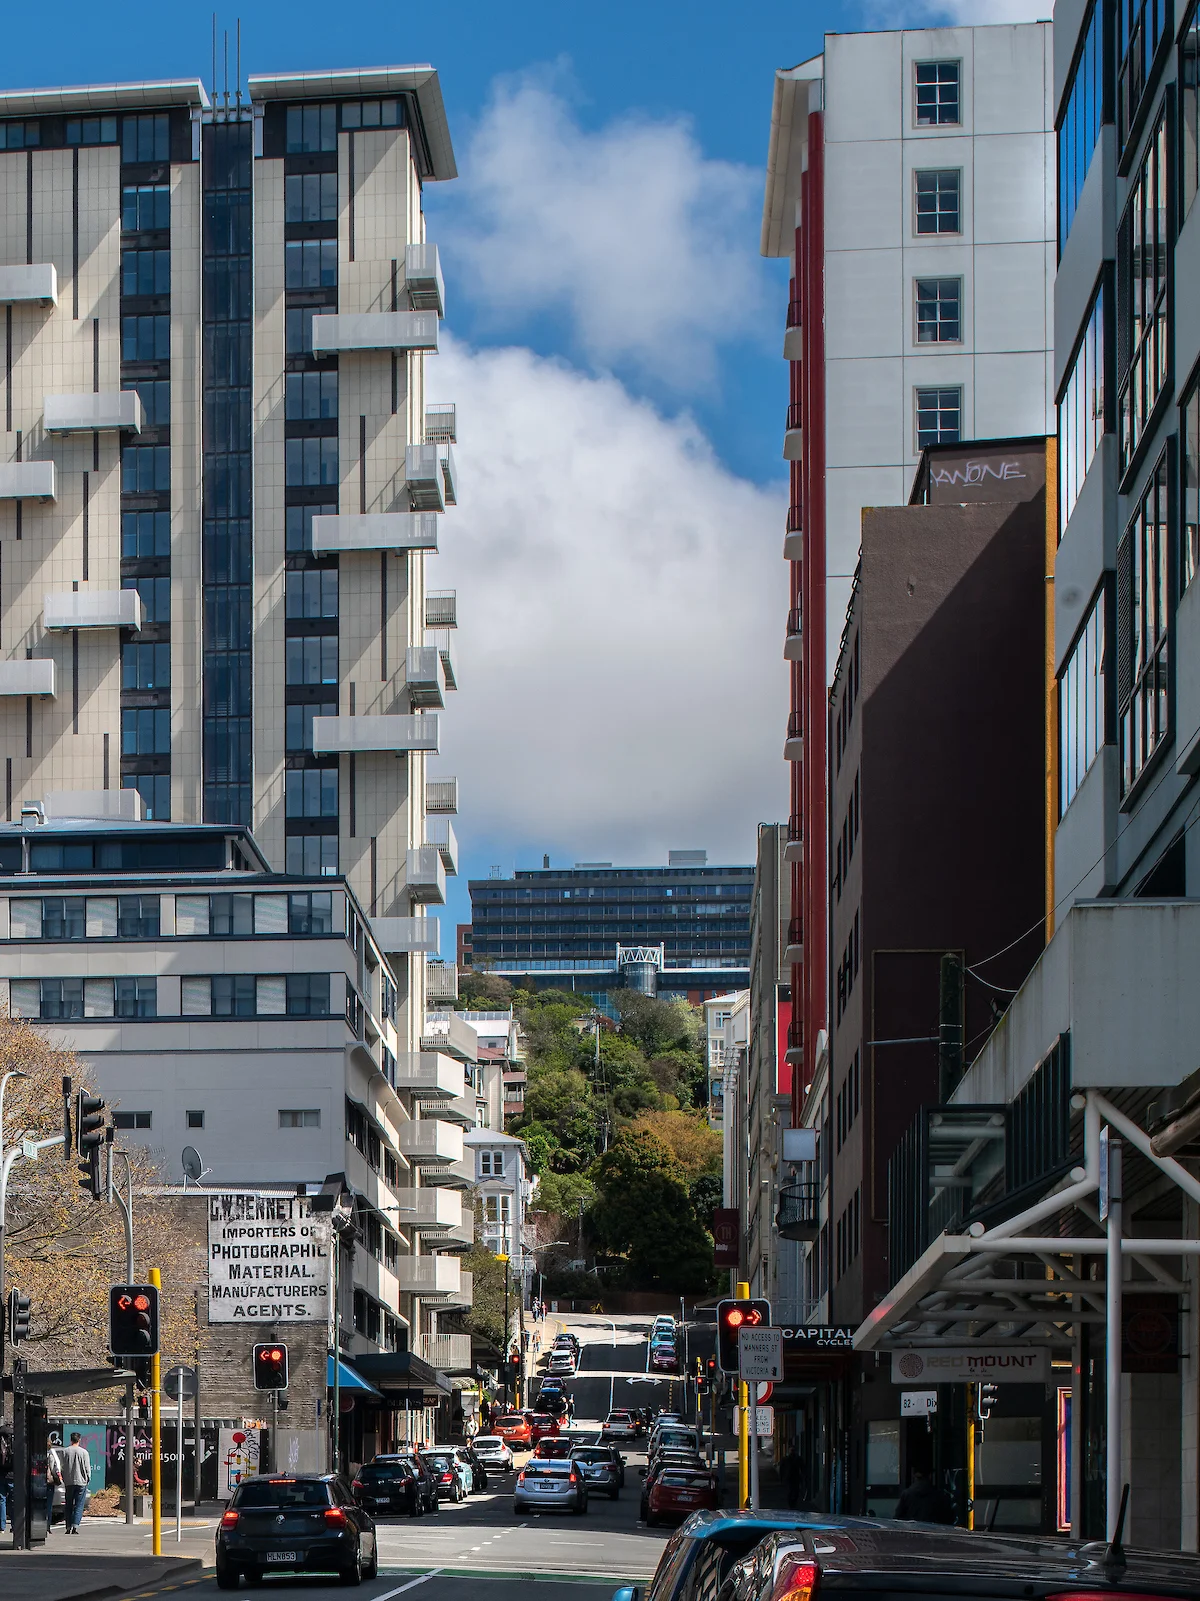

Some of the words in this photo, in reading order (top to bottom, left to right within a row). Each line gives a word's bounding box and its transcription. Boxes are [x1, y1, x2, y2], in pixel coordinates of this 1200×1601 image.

[222, 1226, 296, 1238] IMPORTERS
[211, 1243, 328, 1260] PHOTOGRAPHIC
[228, 1264, 315, 1280] MATERIAL.
[232, 1303, 312, 1317] AGENTS.
[751, 1333, 772, 1342] ACCESS
[781, 1328, 853, 1338] CAPITAL
[743, 1344, 769, 1353] MANNERS
[753, 1355, 769, 1364] FROM
[966, 1354, 1037, 1368] MOUNT
[745, 1366, 769, 1375] VICTORIA
[117, 1435, 147, 1448] Cba
